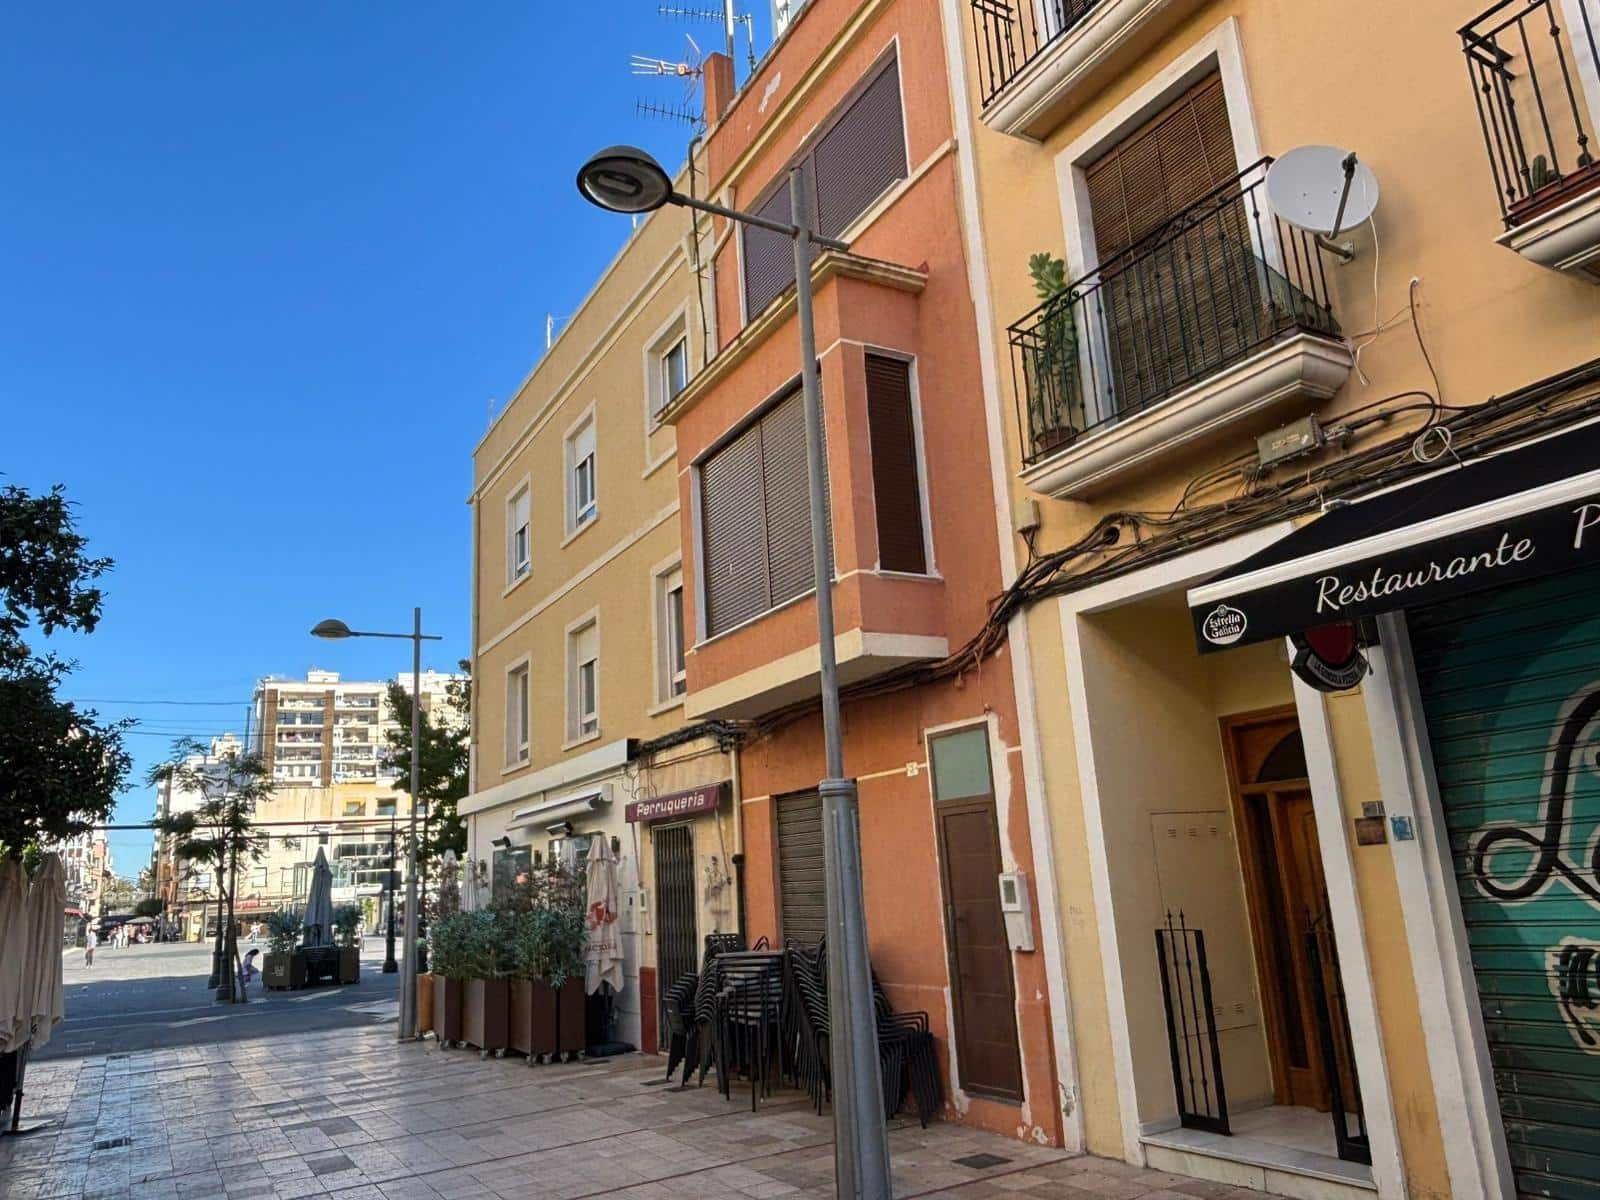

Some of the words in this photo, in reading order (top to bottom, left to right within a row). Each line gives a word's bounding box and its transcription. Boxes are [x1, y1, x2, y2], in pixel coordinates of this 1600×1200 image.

[1315, 532, 1536, 614] Restaurante
[1209, 613, 1241, 628] Estrella
[1211, 624, 1241, 638] Galicia
[636, 792, 705, 817] Perruqueria
